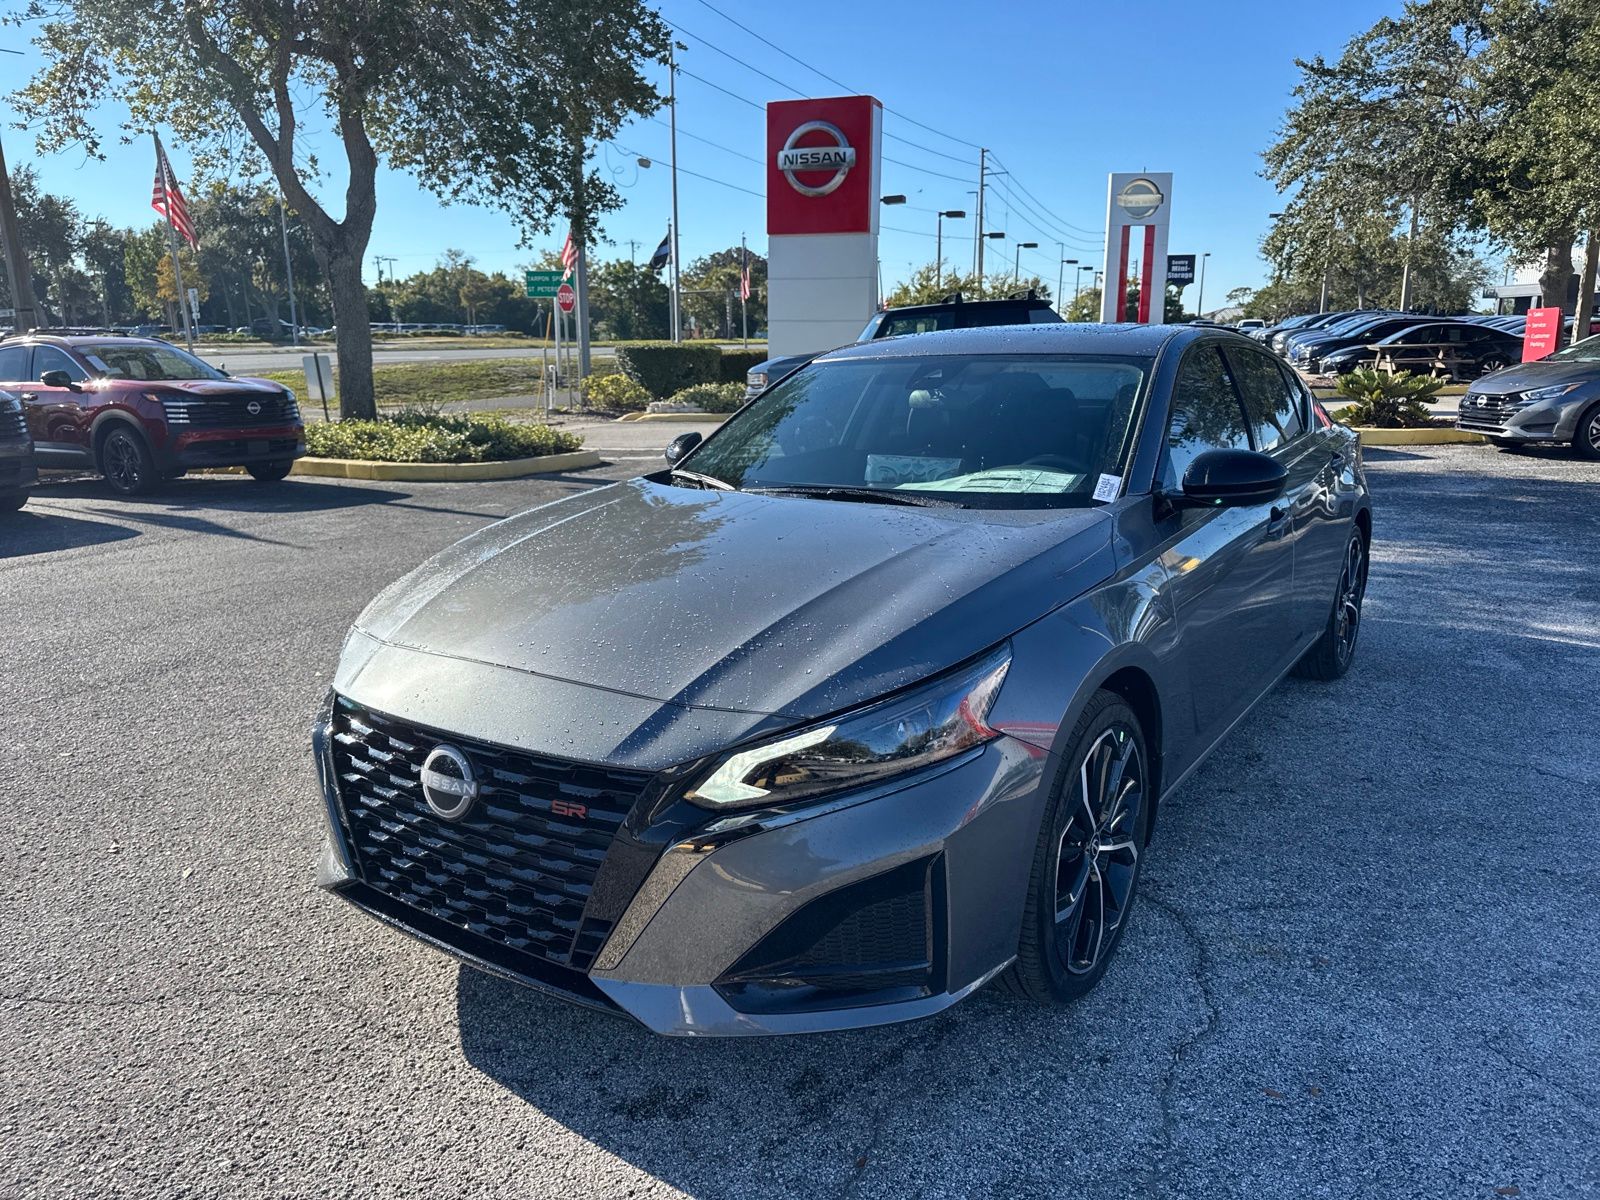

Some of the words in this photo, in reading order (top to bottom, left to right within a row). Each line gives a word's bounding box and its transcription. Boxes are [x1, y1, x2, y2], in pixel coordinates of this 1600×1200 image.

[783, 150, 847, 166] NISSAN
[559, 293, 573, 303] STOP
[421, 769, 476, 795] NISSAN
[551, 799, 588, 820] SR
